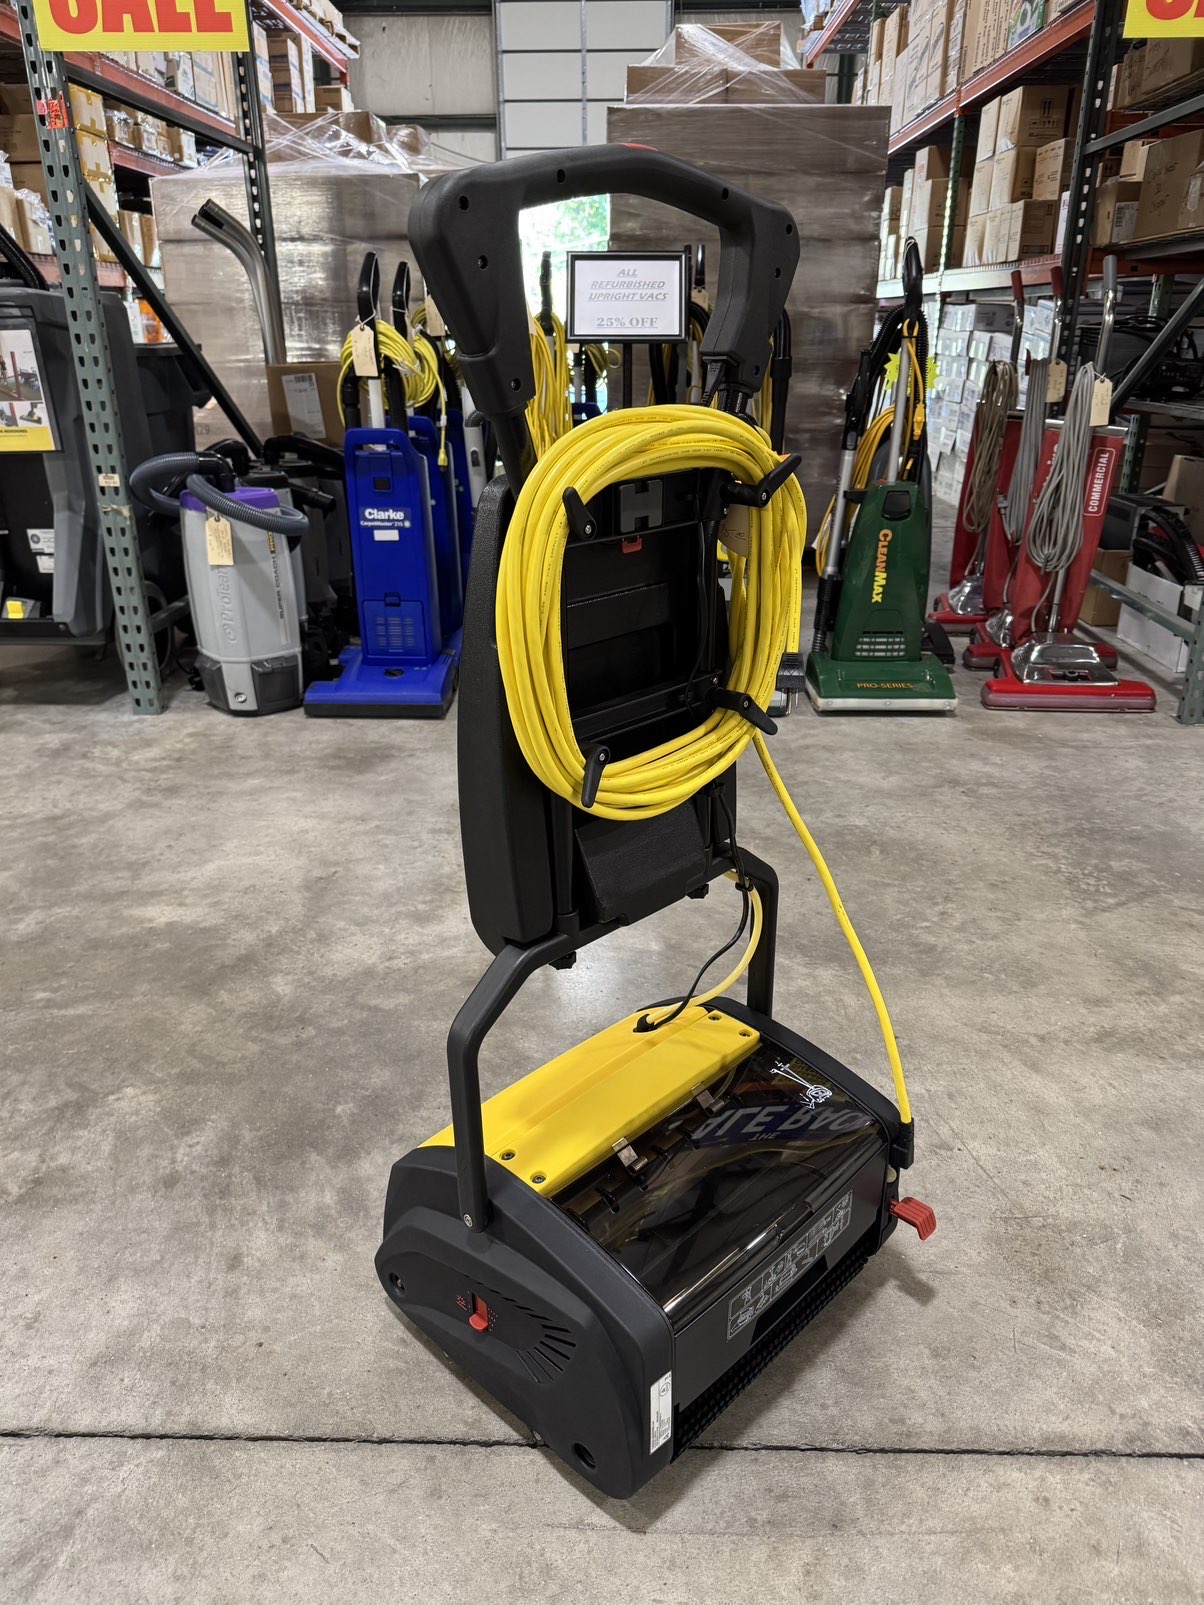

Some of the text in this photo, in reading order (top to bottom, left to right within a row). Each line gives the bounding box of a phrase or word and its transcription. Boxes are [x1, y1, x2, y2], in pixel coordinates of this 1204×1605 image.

[617, 269, 638, 277] ALL
[591, 281, 666, 290] REFURBISHED
[589, 293, 668, 302] UPRIGHT VACS
[596, 317, 658, 328] 25% OFF
[1088, 452, 1110, 512] COMMERCIAL
[364, 508, 405, 520] Clarke
[271, 555, 280, 589] COACH
